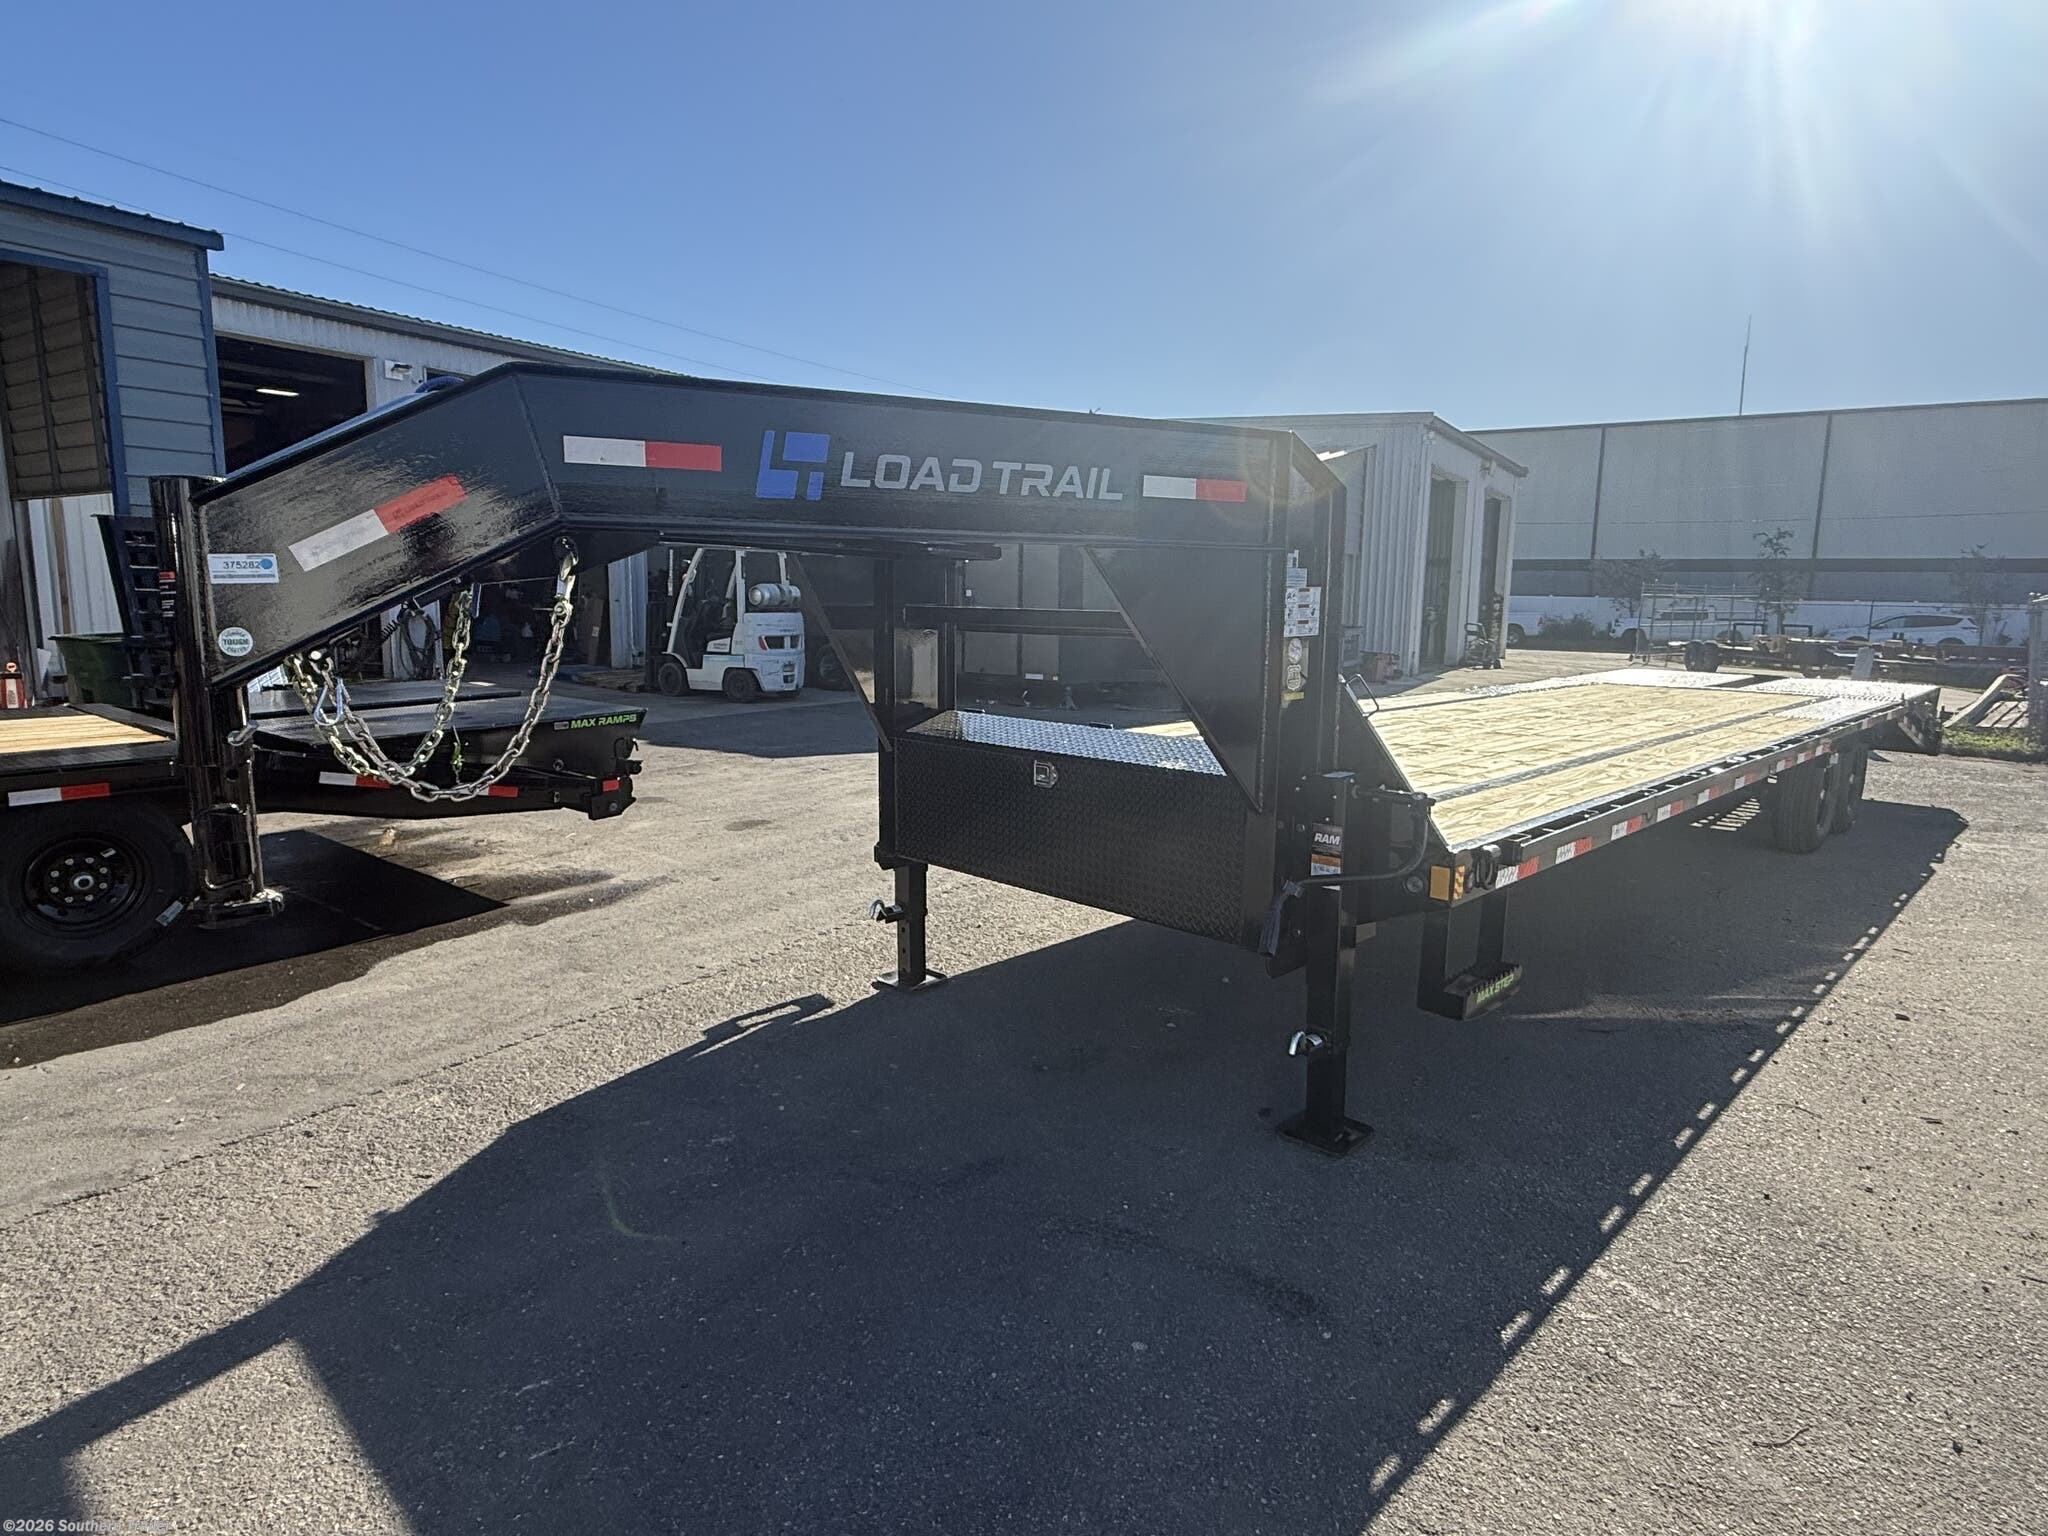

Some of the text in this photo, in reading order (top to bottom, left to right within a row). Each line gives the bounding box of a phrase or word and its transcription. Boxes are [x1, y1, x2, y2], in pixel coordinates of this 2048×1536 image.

[840, 451, 1123, 501] LOAD TRAIL
[223, 561, 260, 570] 375282
[570, 718, 596, 729] MAX
[598, 714, 637, 726] RAMPS
[1314, 833, 1340, 845] RAM
[1476, 973, 1514, 1004] MAX STEP
